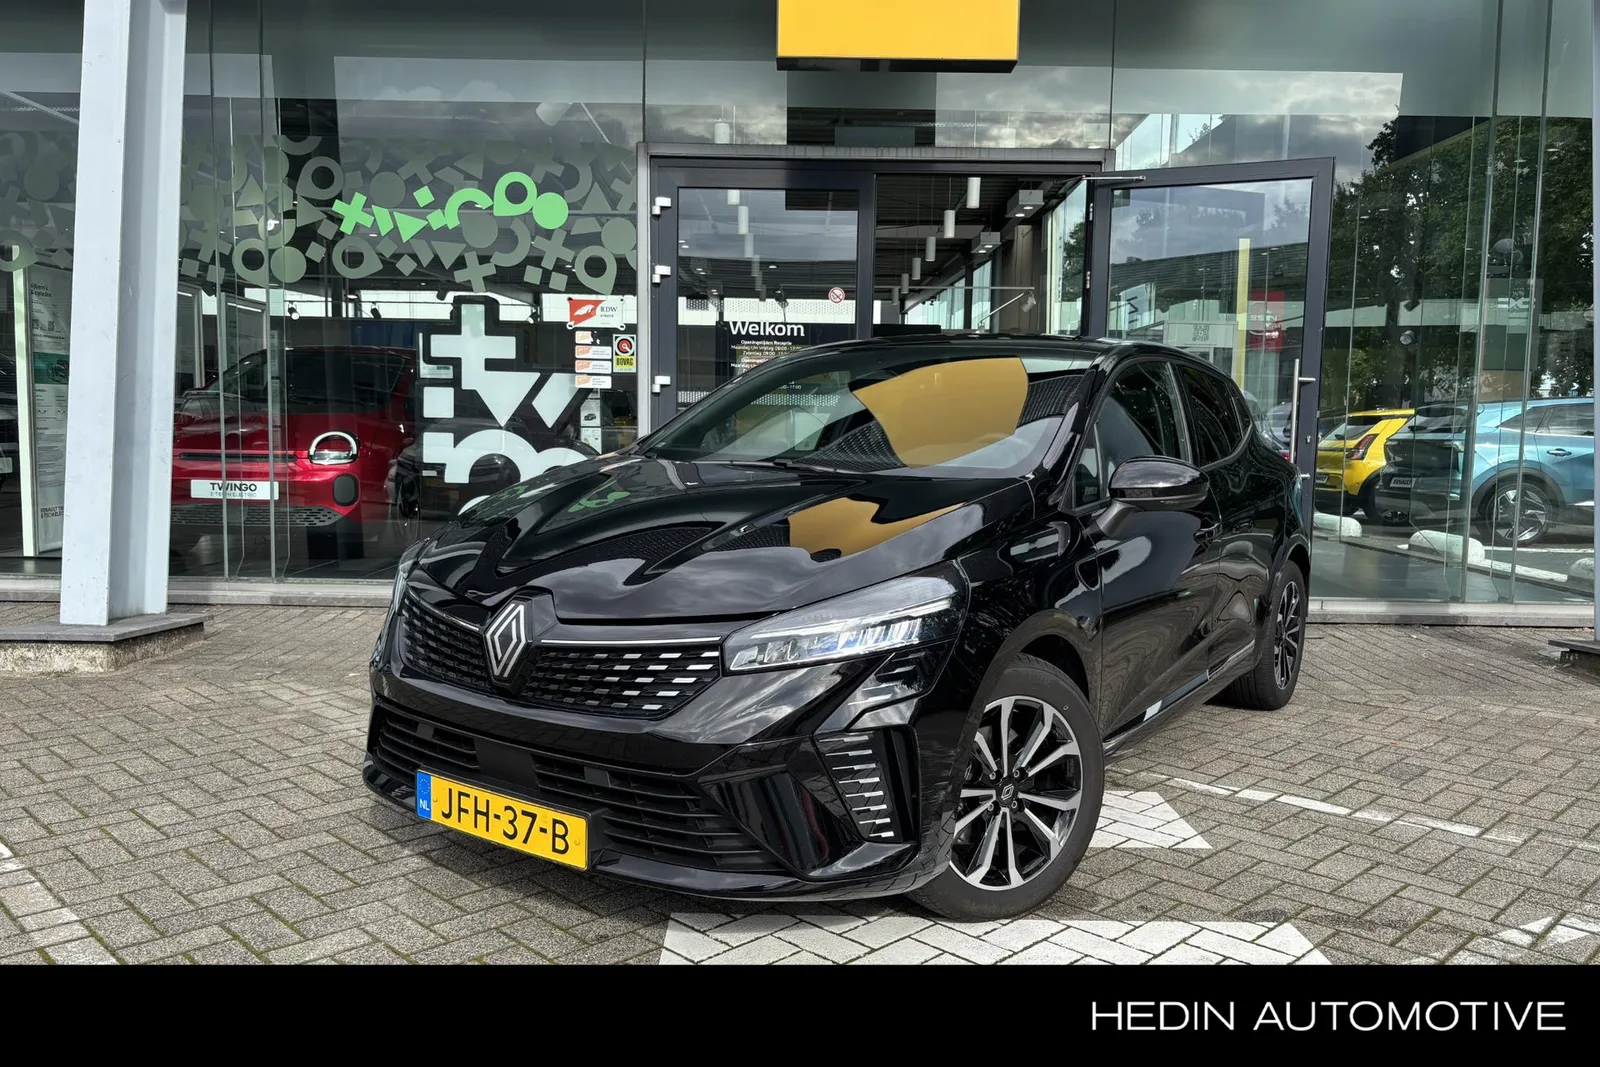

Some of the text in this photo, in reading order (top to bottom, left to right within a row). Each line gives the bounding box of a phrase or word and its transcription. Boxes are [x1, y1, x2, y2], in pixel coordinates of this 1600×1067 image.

[728, 321, 805, 336] Welkom
[616, 357, 634, 366] BOVAG
[209, 482, 257, 492] TWINGO
[418, 787, 570, 855] NL JFH-37-B
